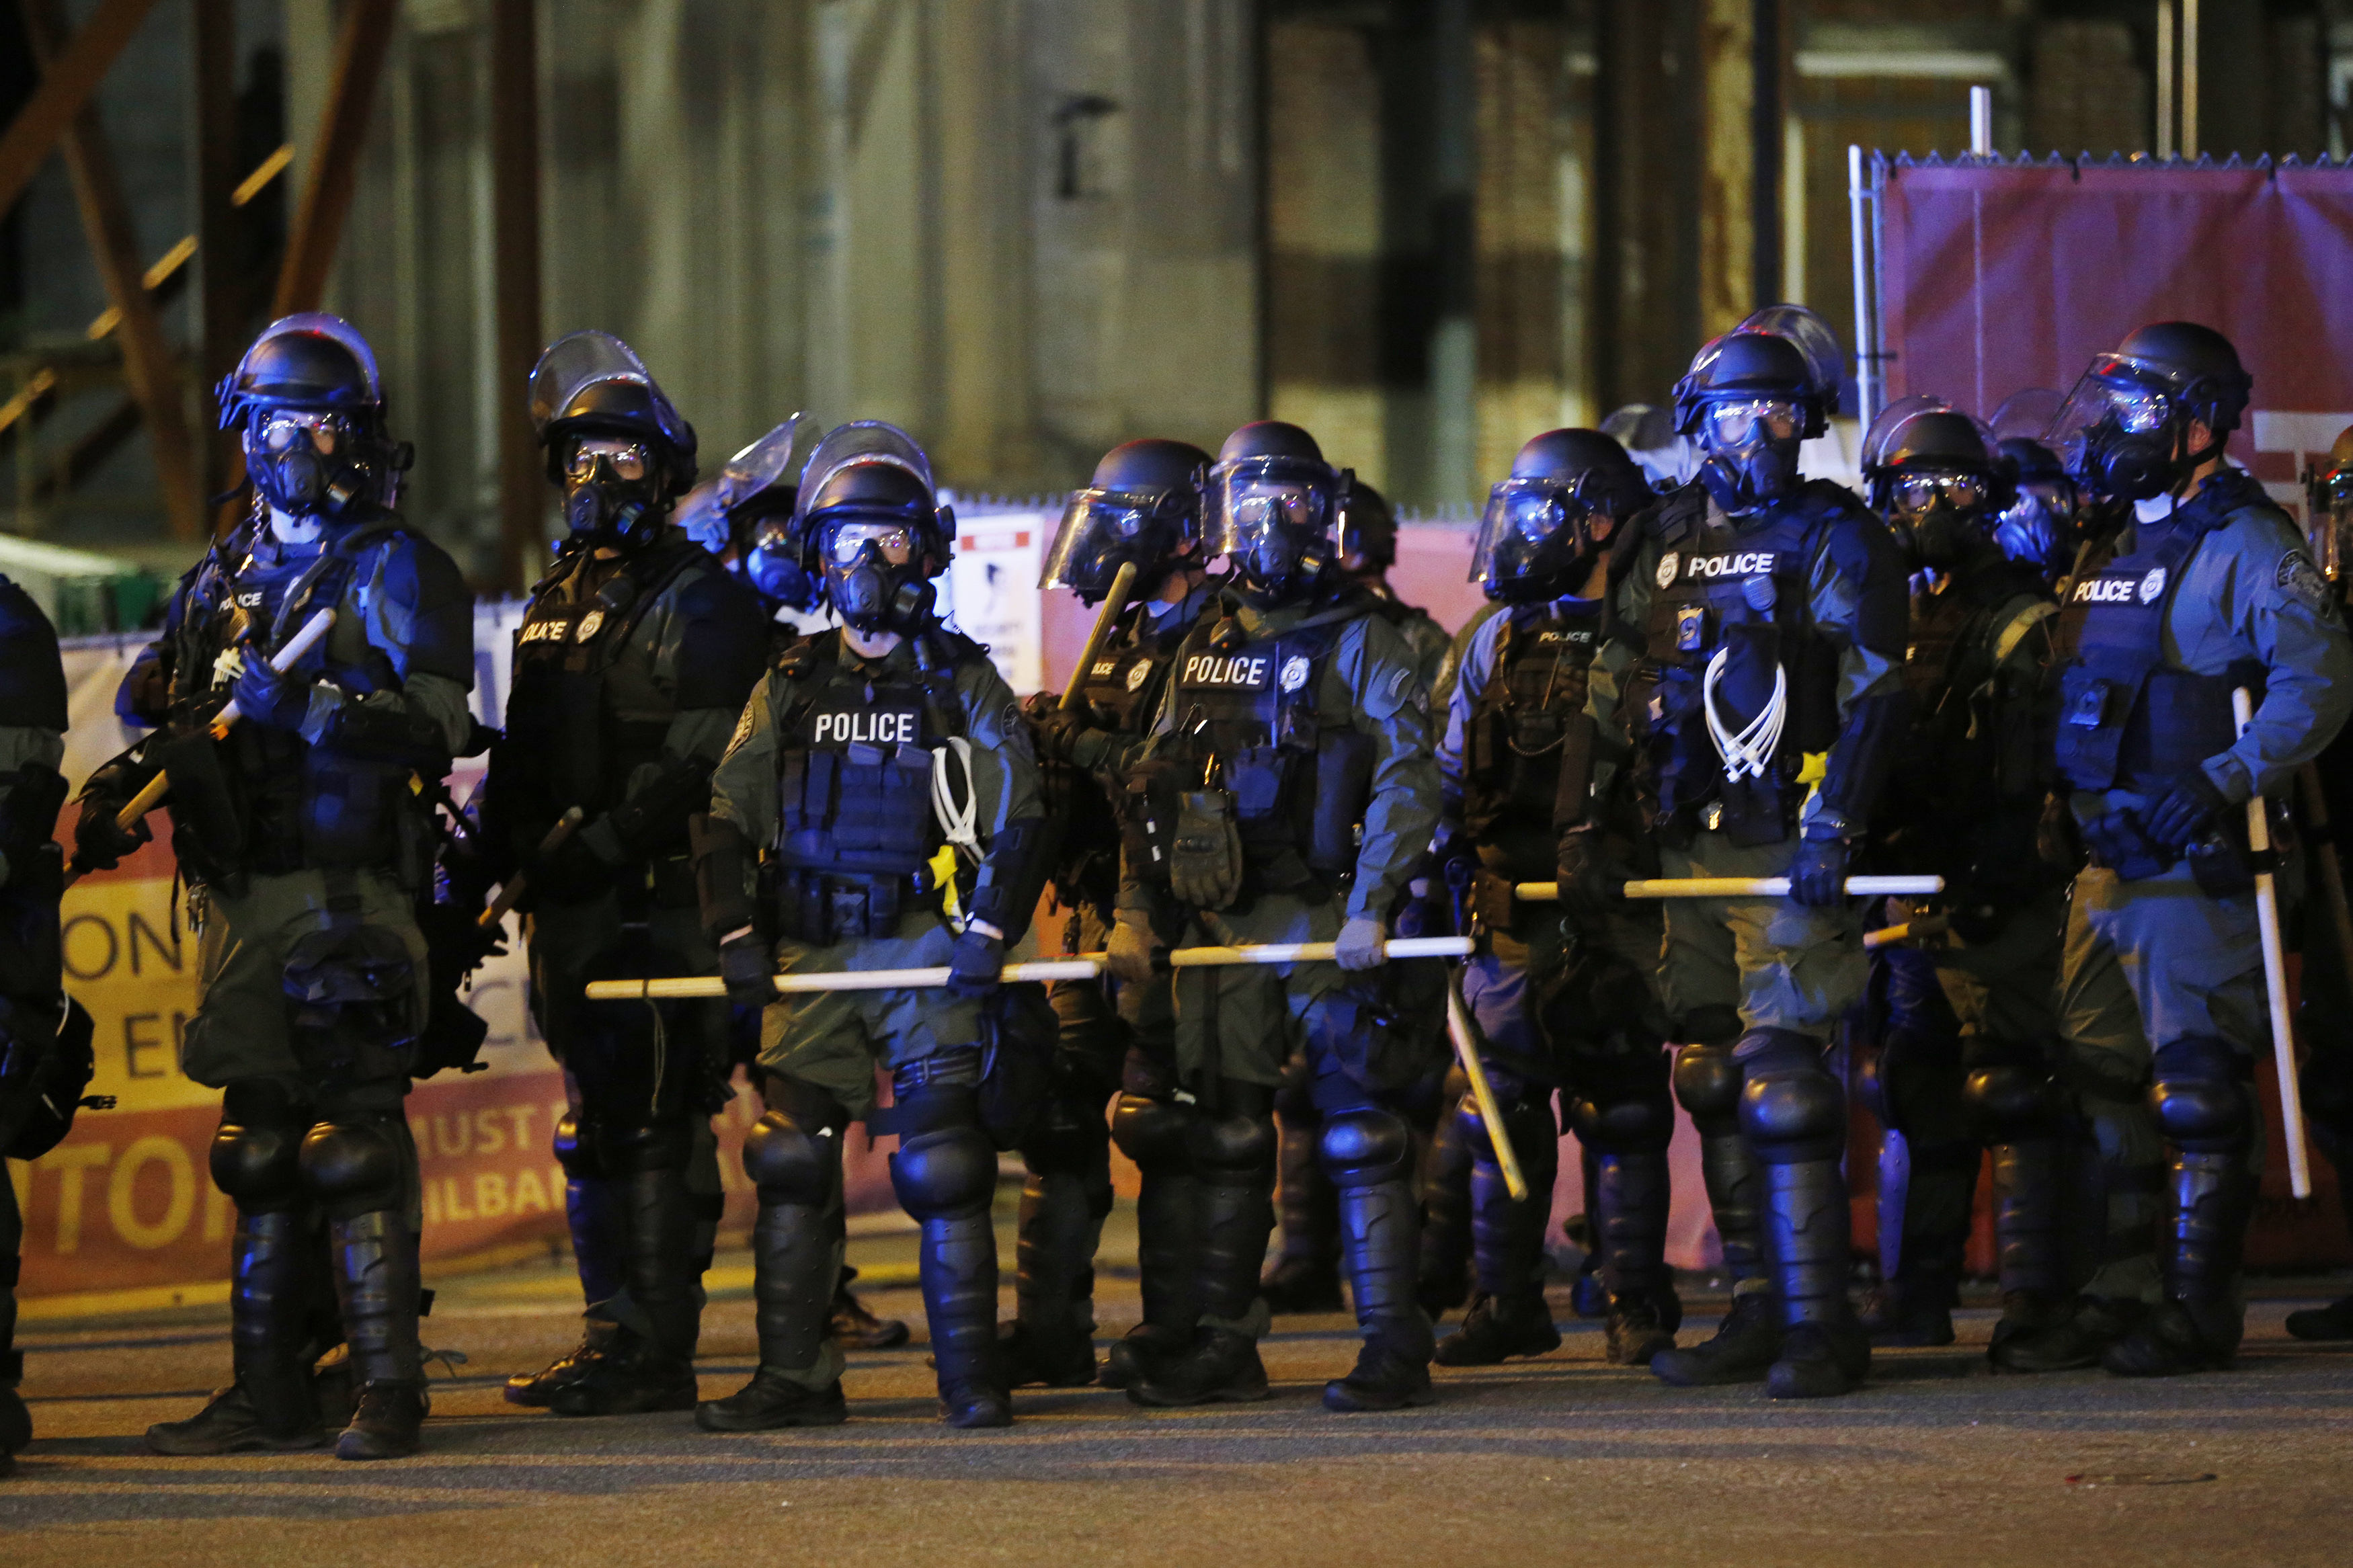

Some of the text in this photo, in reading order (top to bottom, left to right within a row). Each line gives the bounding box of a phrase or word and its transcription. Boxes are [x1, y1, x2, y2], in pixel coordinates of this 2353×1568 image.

[1688, 553, 1775, 577] POLICE
[218, 591, 263, 613] POICE
[2073, 580, 2136, 602] POLICE
[1183, 655, 1267, 685] POLICE
[815, 712, 914, 743] POLICE
